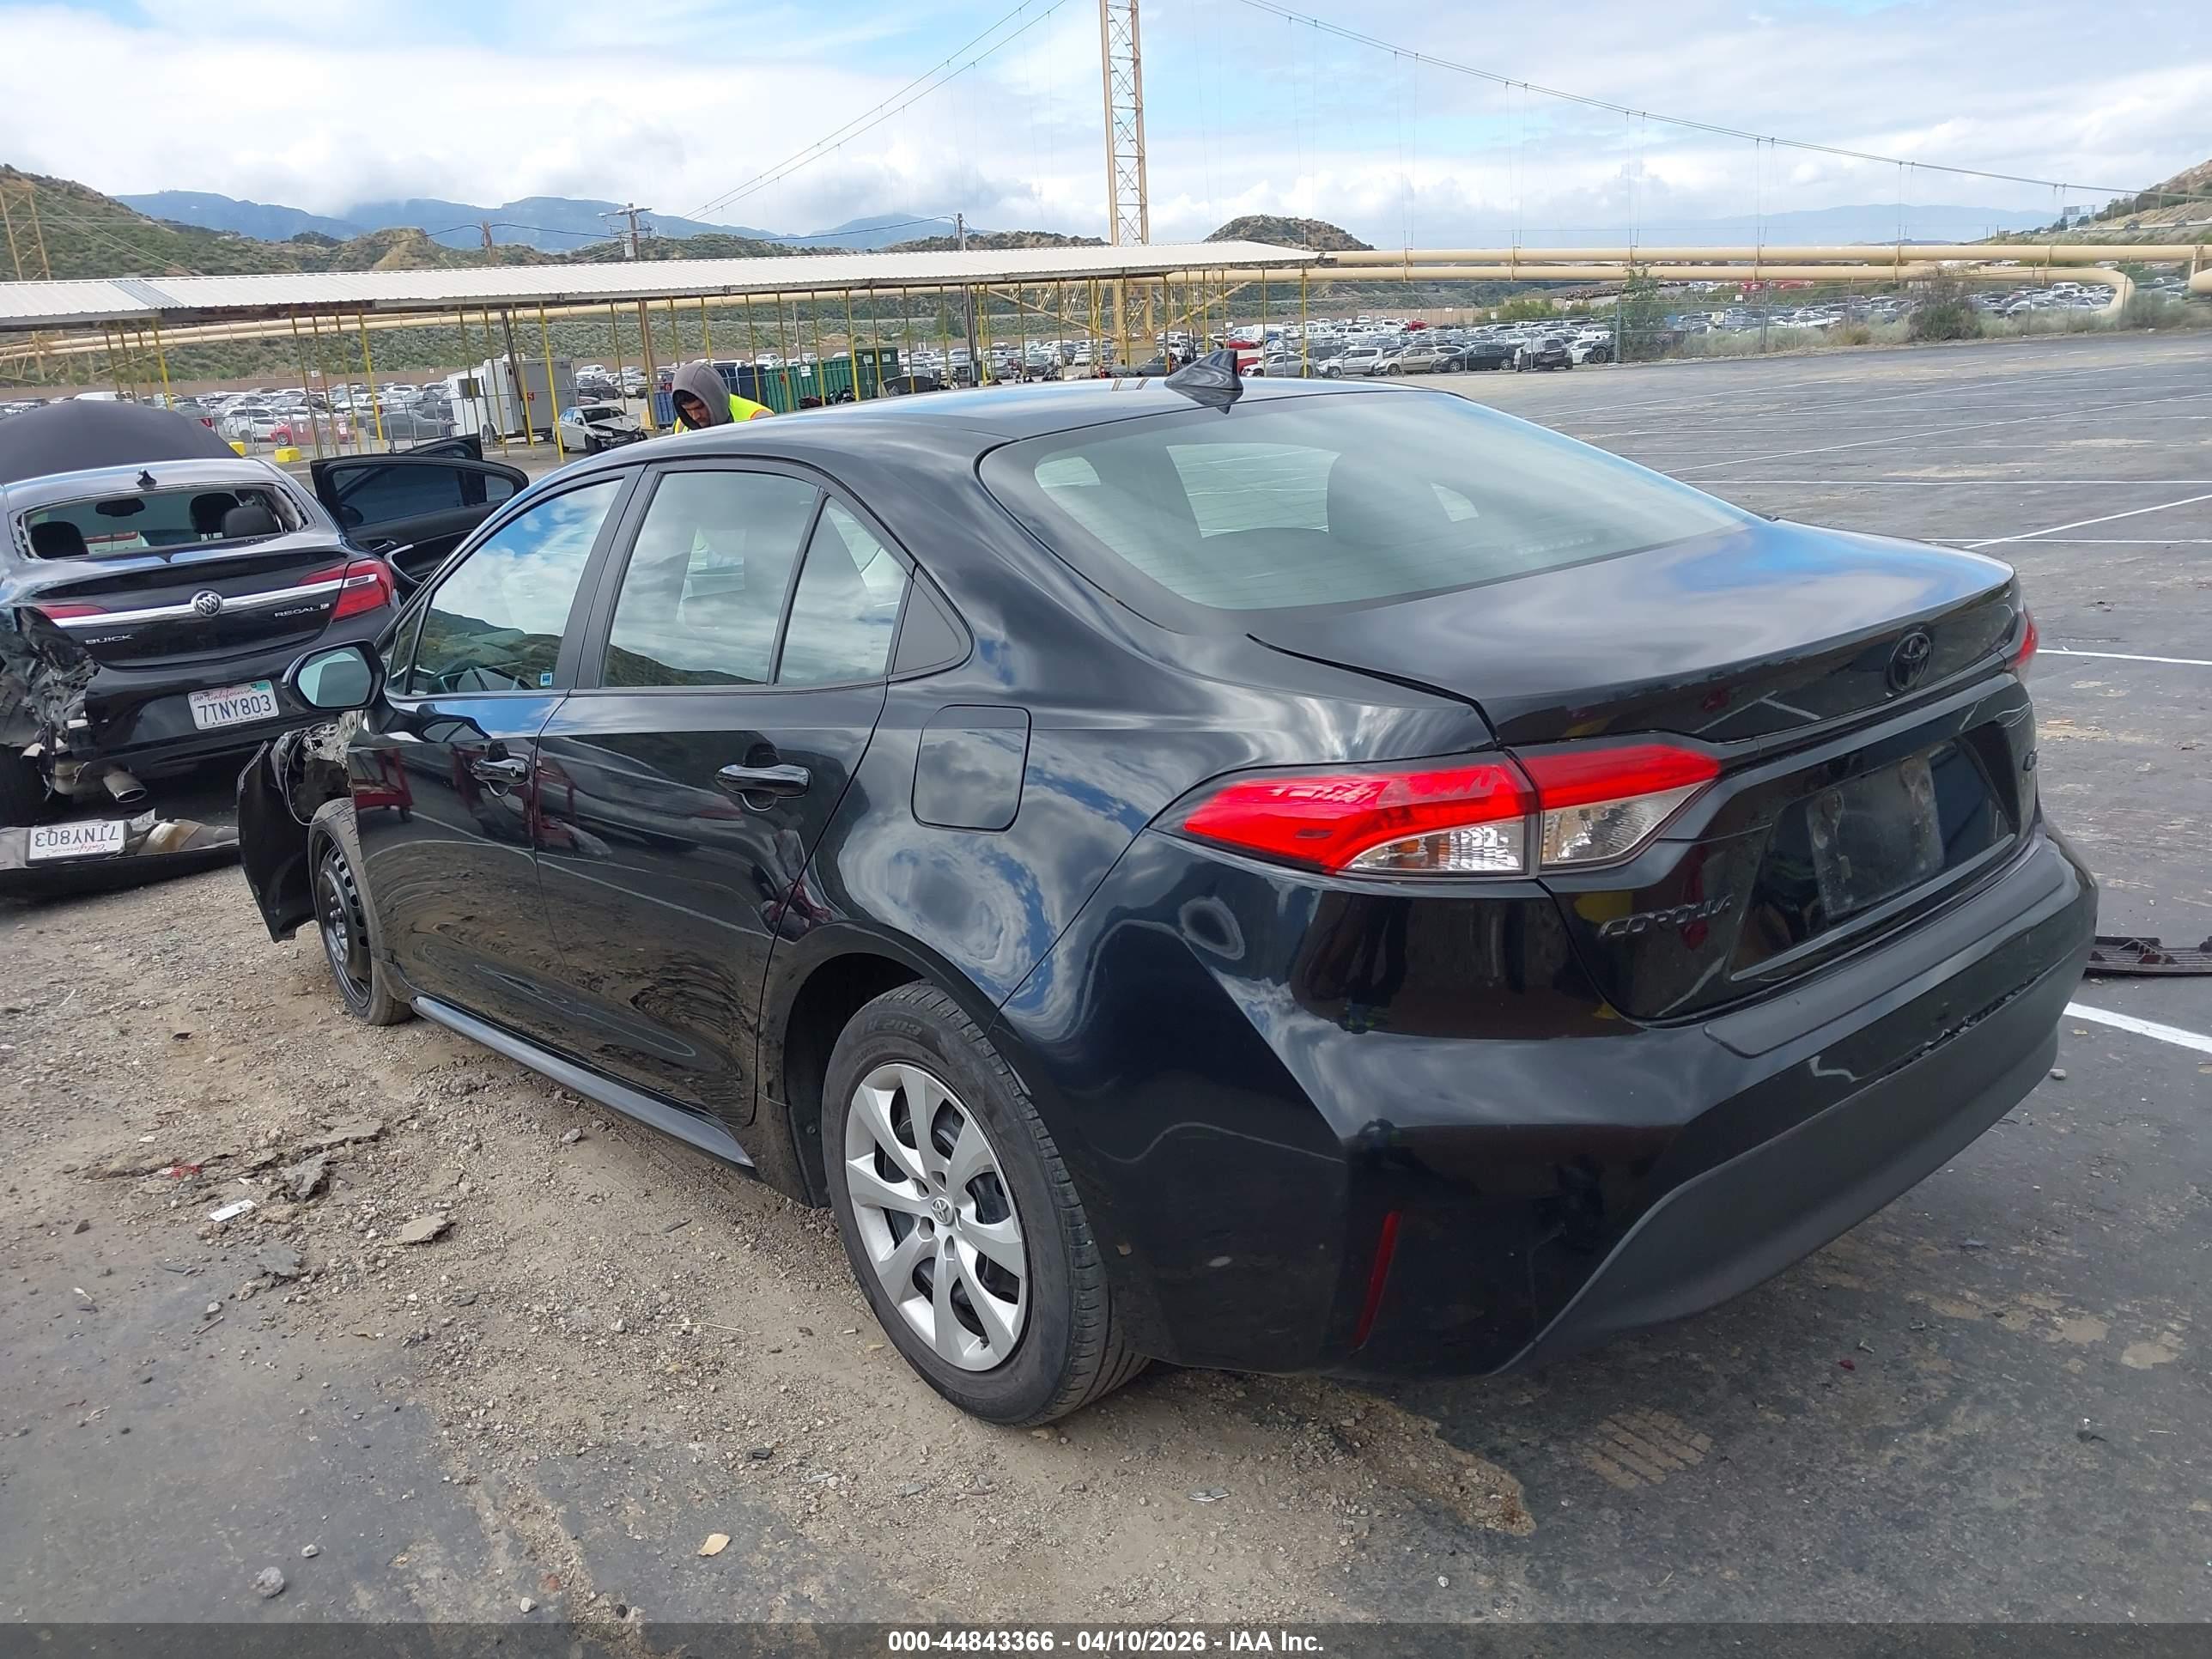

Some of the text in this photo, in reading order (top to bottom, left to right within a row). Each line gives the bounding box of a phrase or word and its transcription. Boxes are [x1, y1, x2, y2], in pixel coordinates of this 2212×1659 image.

[275, 606, 319, 617] REGAL
[85, 634, 134, 645] BUICK
[198, 694, 272, 723] 7TNY803
[34, 825, 119, 848] 7TNY803
